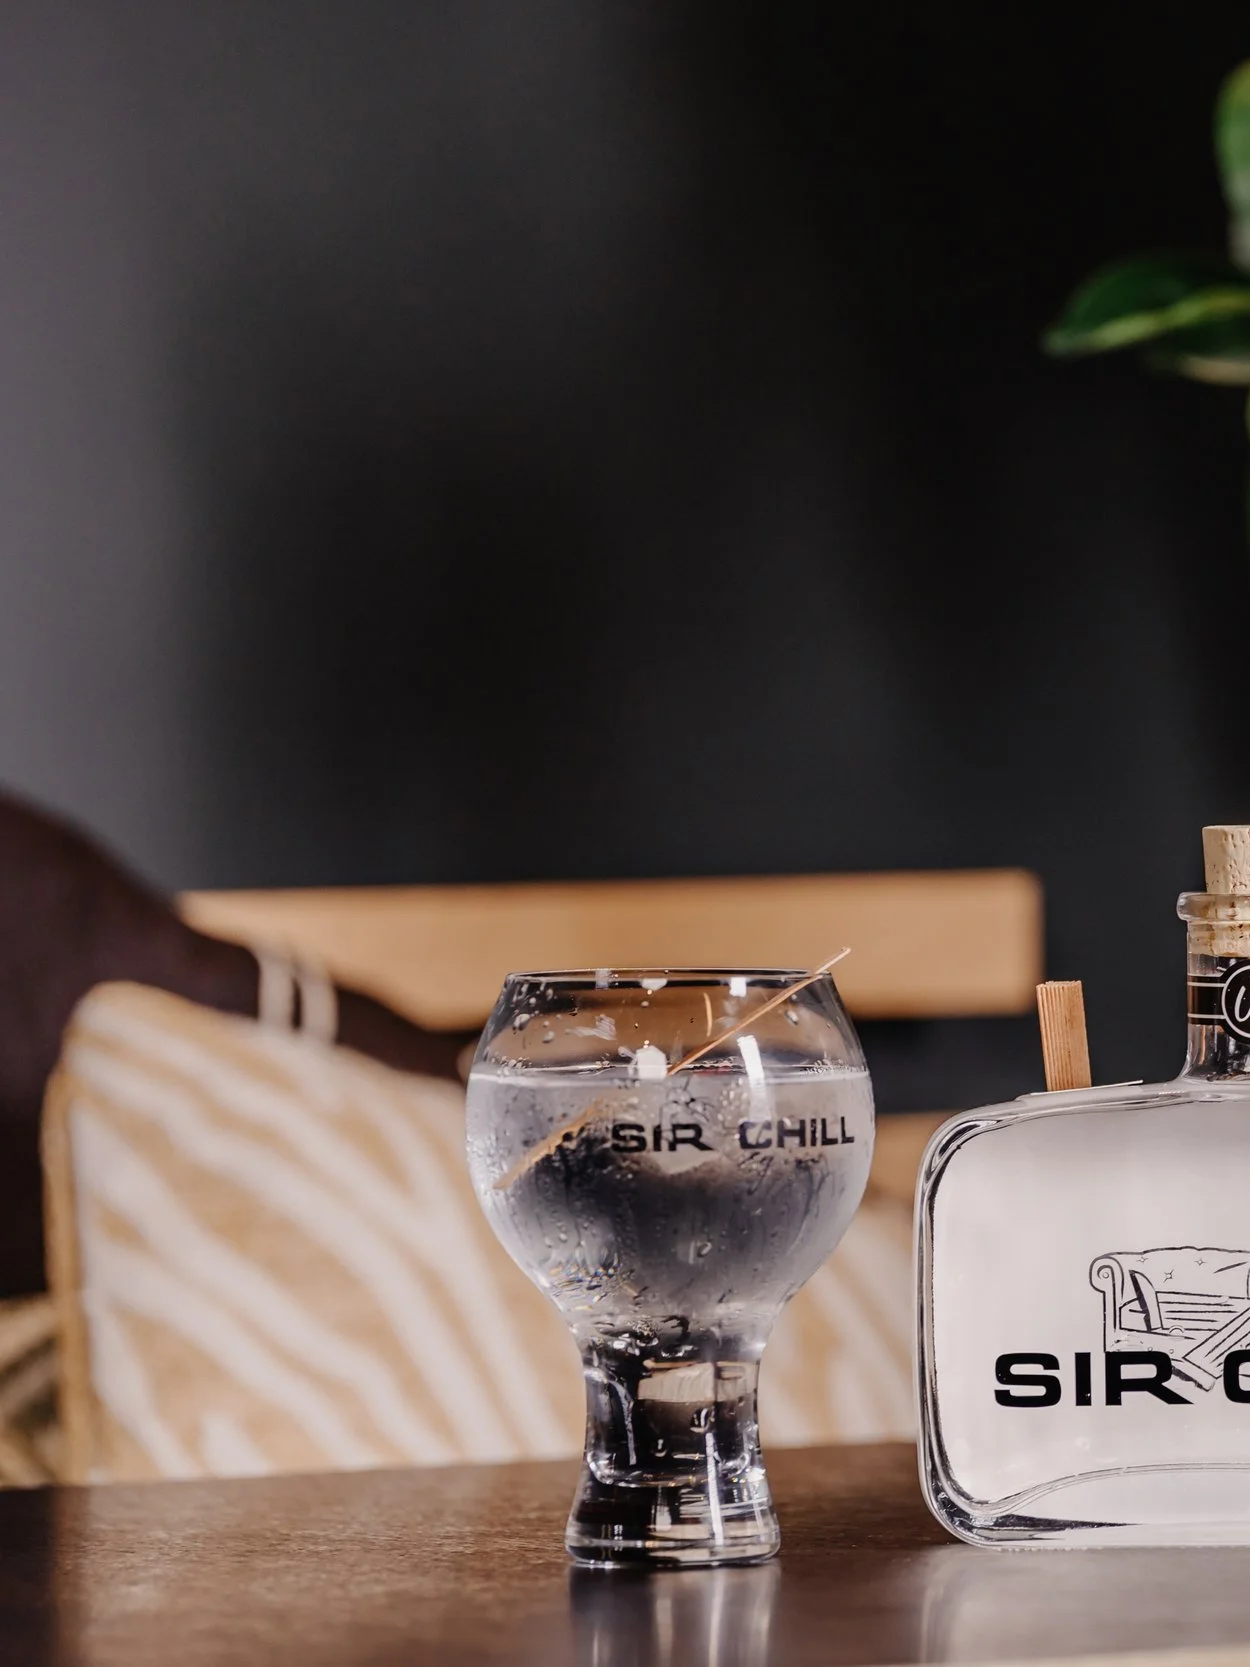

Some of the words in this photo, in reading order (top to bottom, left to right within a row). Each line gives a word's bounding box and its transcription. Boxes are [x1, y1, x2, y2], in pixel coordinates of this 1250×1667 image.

[610, 1122, 715, 1152] SIR
[738, 1116, 855, 1150] CHILL
[993, 1351, 1195, 1408] SIR
